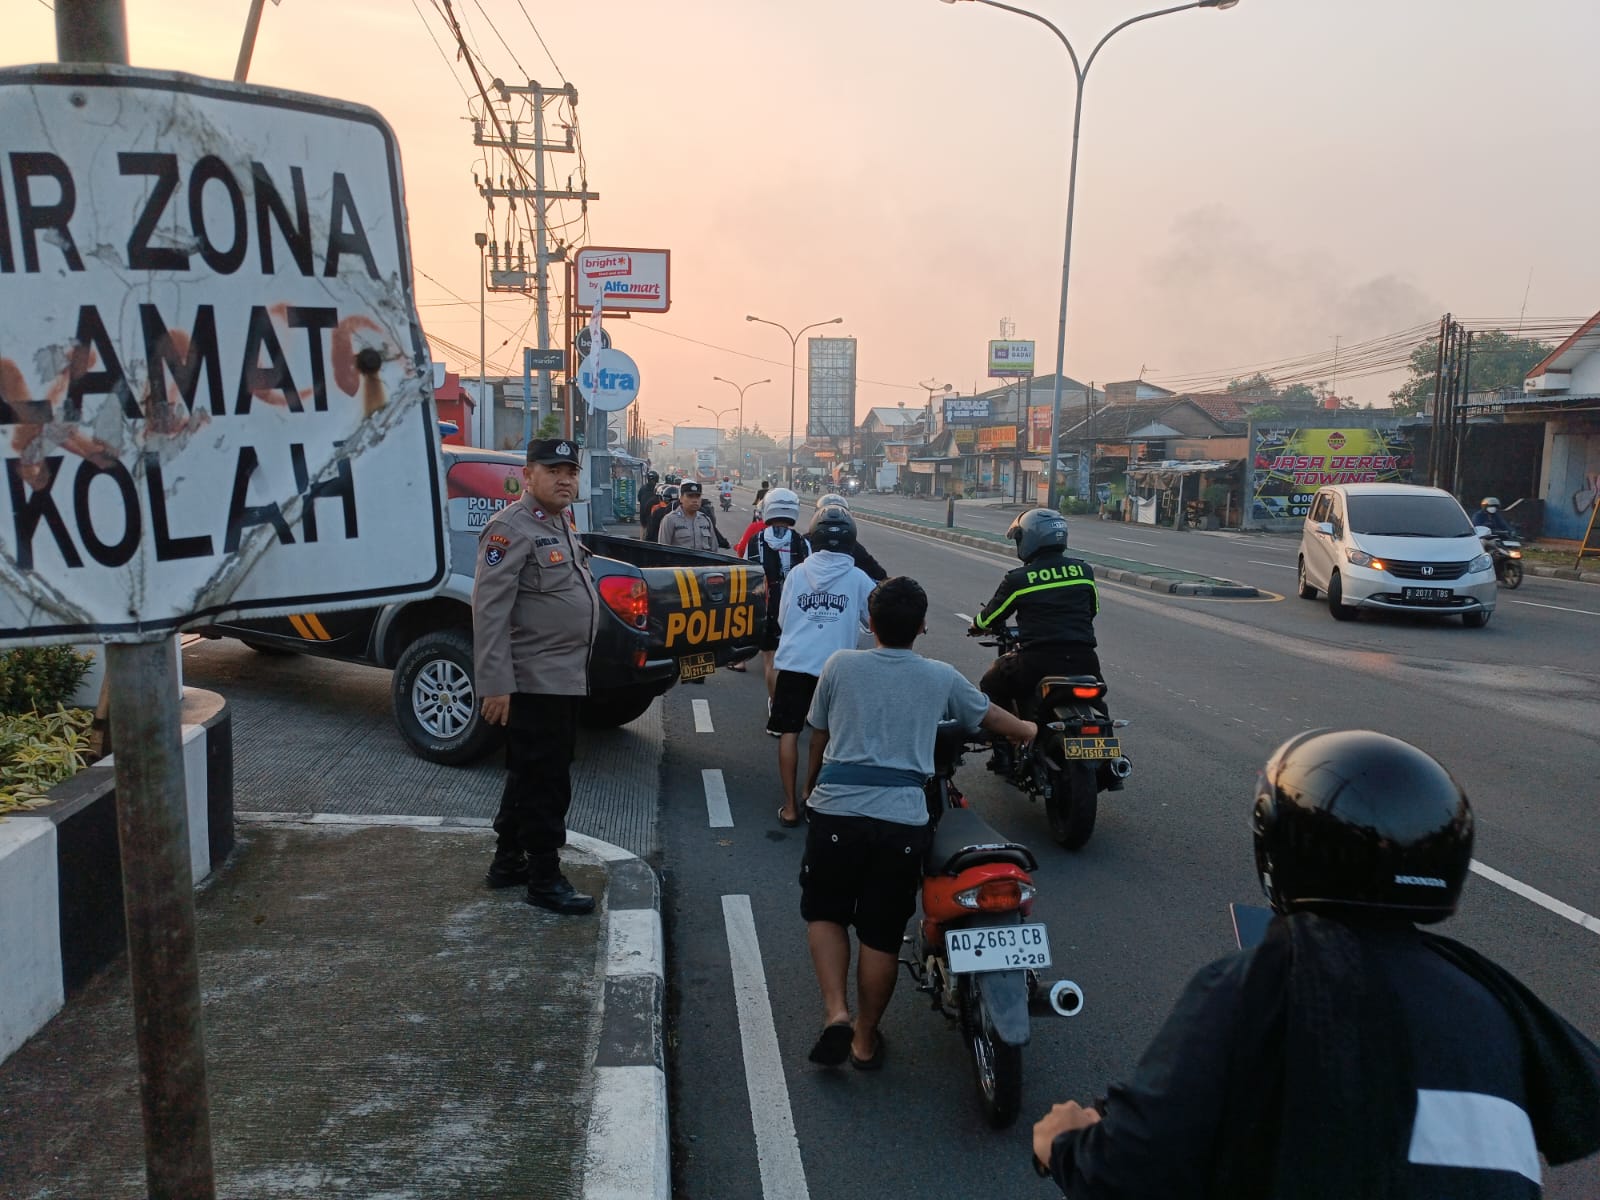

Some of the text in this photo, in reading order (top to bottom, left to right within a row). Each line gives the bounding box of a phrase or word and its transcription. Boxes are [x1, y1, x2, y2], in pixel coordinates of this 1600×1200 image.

[117, 151, 381, 279] ZONA
[585, 256, 617, 269] bright
[588, 280, 661, 294] by Alfamart
[582, 367, 635, 391] utra
[1269, 455, 1402, 470] JASA DEREK
[1293, 471, 1378, 486] TOWING
[5, 442, 359, 570] KOLAH
[1026, 564, 1084, 584] POLISI
[665, 604, 754, 648] POLISI
[1094, 738, 1106, 748] IX
[951, 928, 1042, 952] AD 2663 CB
